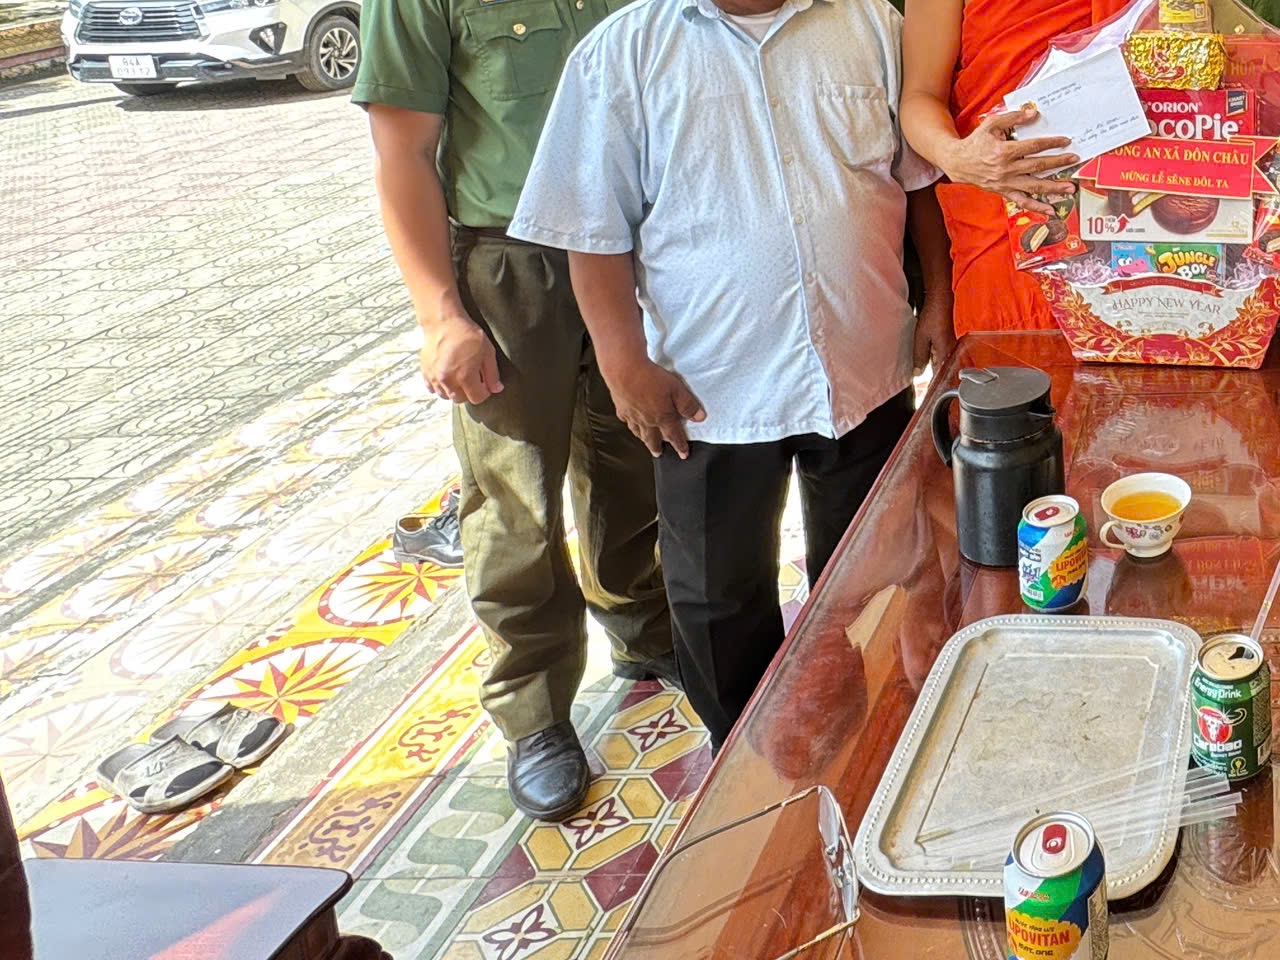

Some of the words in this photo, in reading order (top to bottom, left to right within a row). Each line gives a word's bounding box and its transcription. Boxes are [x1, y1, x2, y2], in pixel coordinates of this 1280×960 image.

[1151, 102, 1200, 114] ORION
[1143, 145, 1161, 159] AN
[1163, 145, 1180, 161] XÃ
[1183, 147, 1210, 162] ĐÔN
[1213, 149, 1249, 165] CHÂU
[1216, 178, 1229, 189] TA
[1158, 251, 1216, 274] JUNGLE
[1177, 263, 1208, 280] BOY
[1112, 296, 1153, 311] HAPPY
[1155, 296, 1186, 310] NEW
[1189, 299, 1222, 315] YEAR
[1194, 677, 1220, 700] Energy
[1218, 688, 1242, 699] Drink
